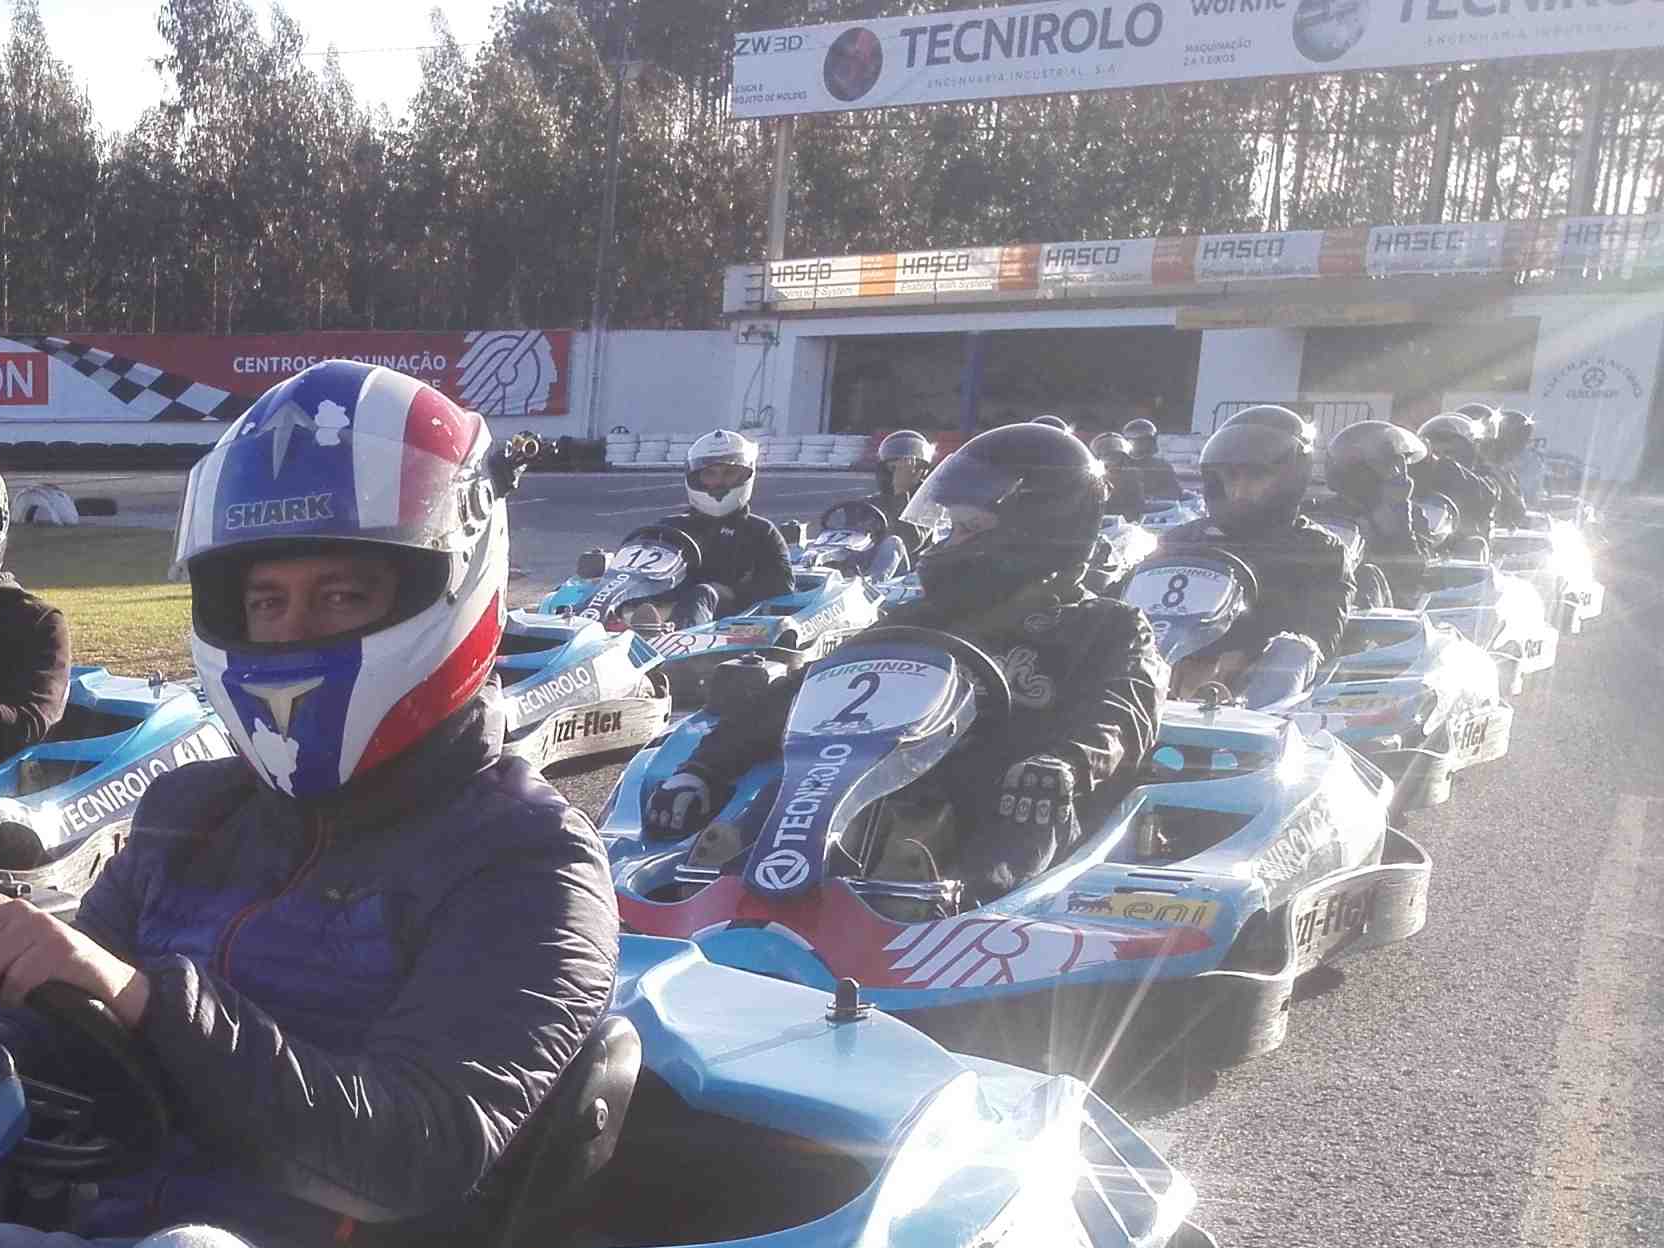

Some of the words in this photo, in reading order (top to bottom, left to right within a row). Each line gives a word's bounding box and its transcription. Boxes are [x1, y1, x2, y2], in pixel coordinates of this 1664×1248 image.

[899, 3, 1163, 68] TECNIROLO
[1045, 246, 1120, 267] HASCO
[1202, 238, 1284, 260] HASCO
[770, 263, 832, 284] HASCO
[901, 254, 969, 275] HASCO
[233, 356, 317, 374] CENTROS
[225, 491, 337, 530] SHARK
[627, 549, 664, 569] 12
[1161, 574, 1188, 608] 8
[818, 658, 929, 682] EUROINDY
[509, 666, 591, 719] TECNIROLO
[836, 672, 880, 722] 2
[1123, 899, 1210, 926] eni
